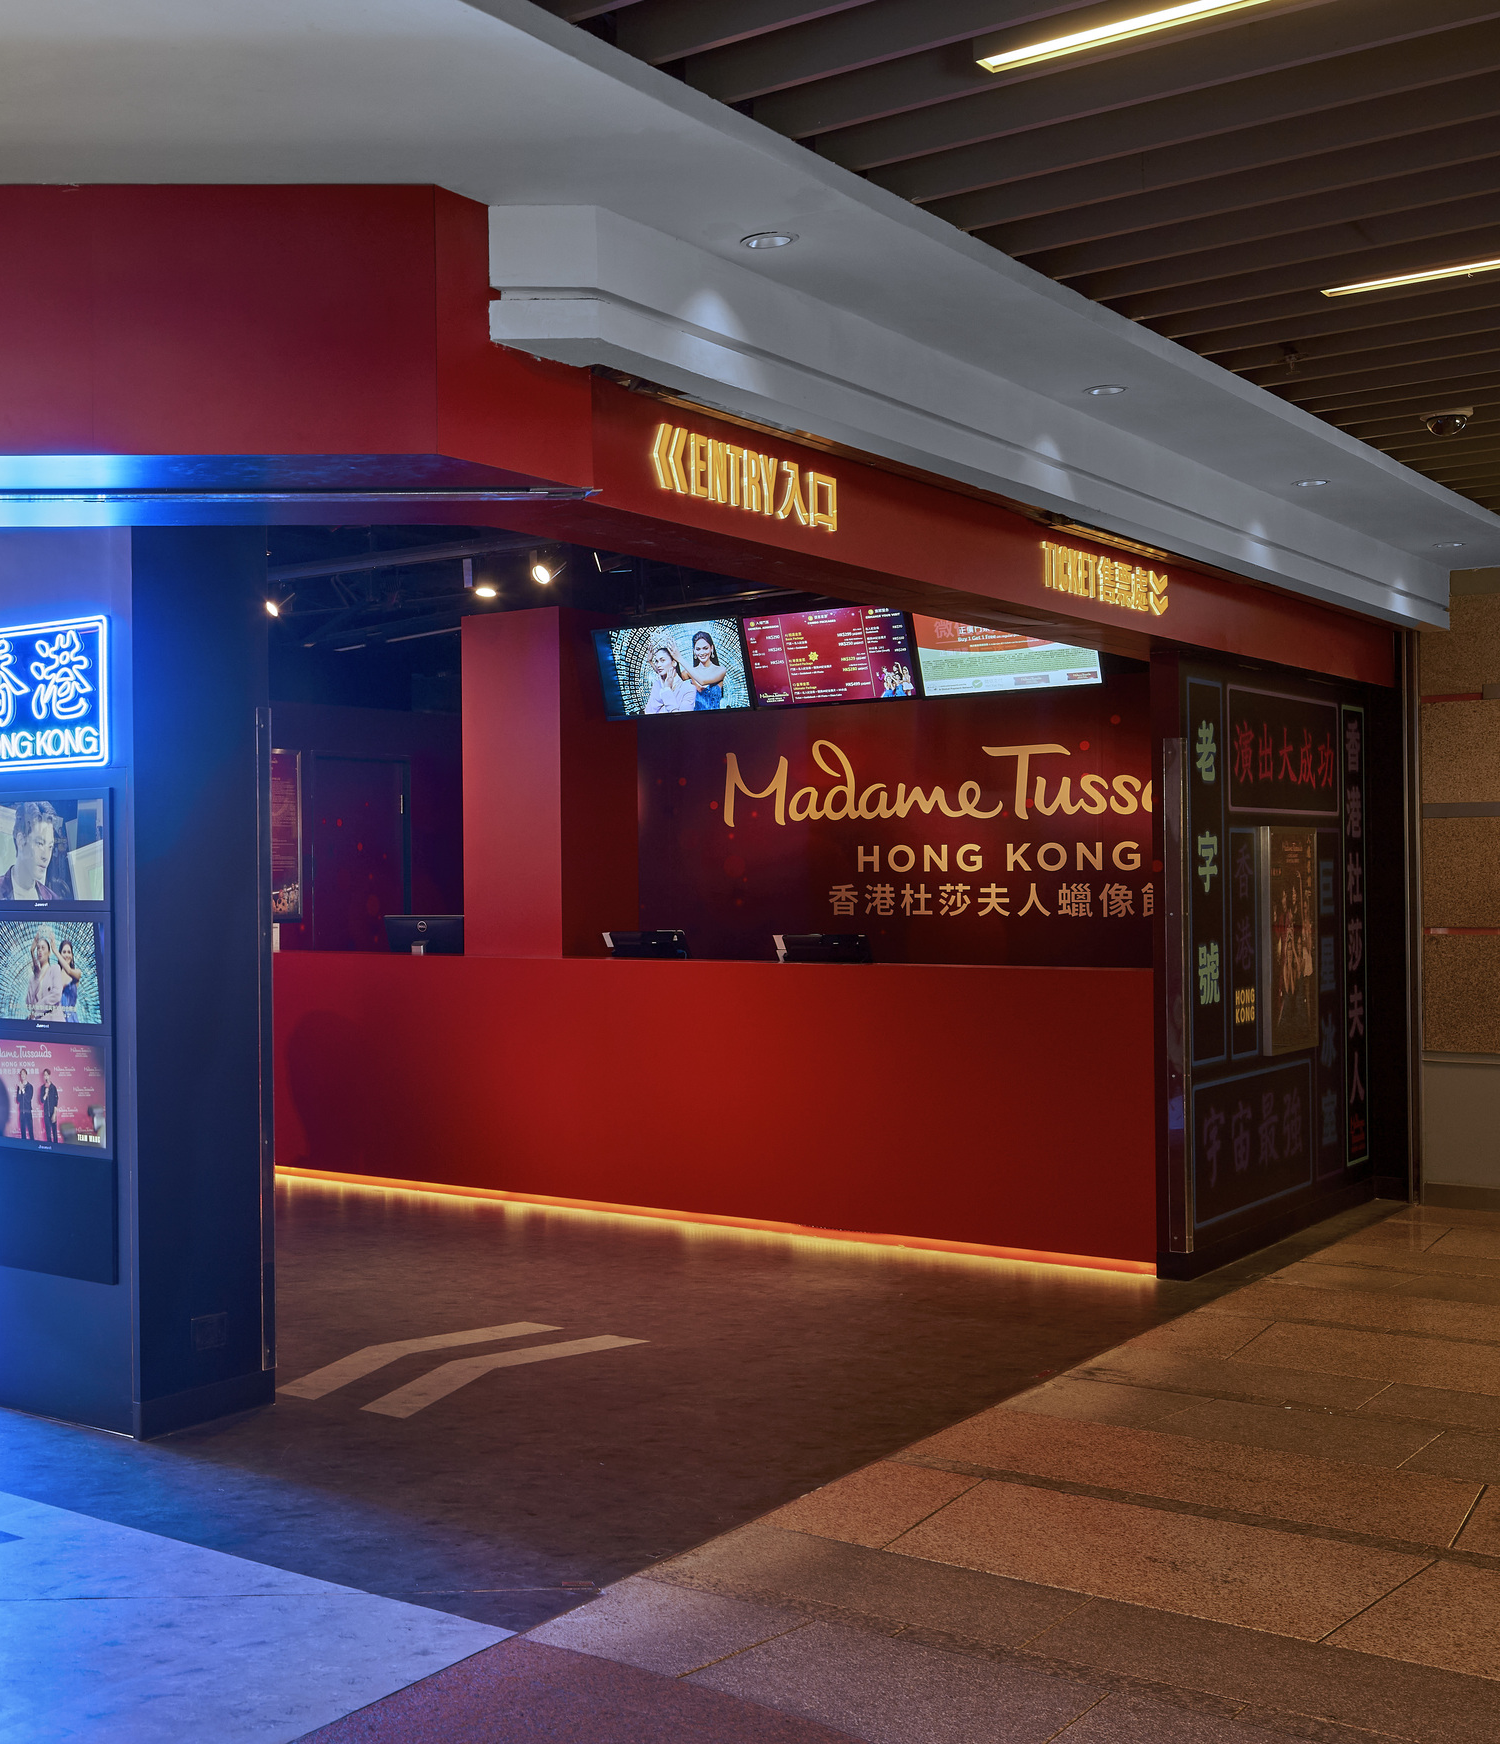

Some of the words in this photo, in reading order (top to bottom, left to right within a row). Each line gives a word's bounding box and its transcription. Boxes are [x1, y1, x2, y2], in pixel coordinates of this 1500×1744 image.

[689, 432, 778, 517] ENTRY
[777, 459, 839, 533] 入口
[1040, 540, 1098, 599] TICKET
[36, 726, 100, 756] KONG
[1232, 719, 1336, 790] 演出大成功
[722, 739, 1003, 828] Madame
[981, 743, 1153, 821] Tuss
[857, 843, 984, 873] HONG
[1006, 841, 1141, 872] KONG
[1195, 719, 1222, 1007] 老字號
[1233, 842, 1256, 971] 香港
[1345, 718, 1367, 1105] 香港杜莎夫人
[1235, 987, 1256, 1006] HONG
[1235, 1005, 1256, 1025] KONG
[15, 1044, 52, 1059] Tussauds
[1202, 1085, 1305, 1189] 宇宙最強
